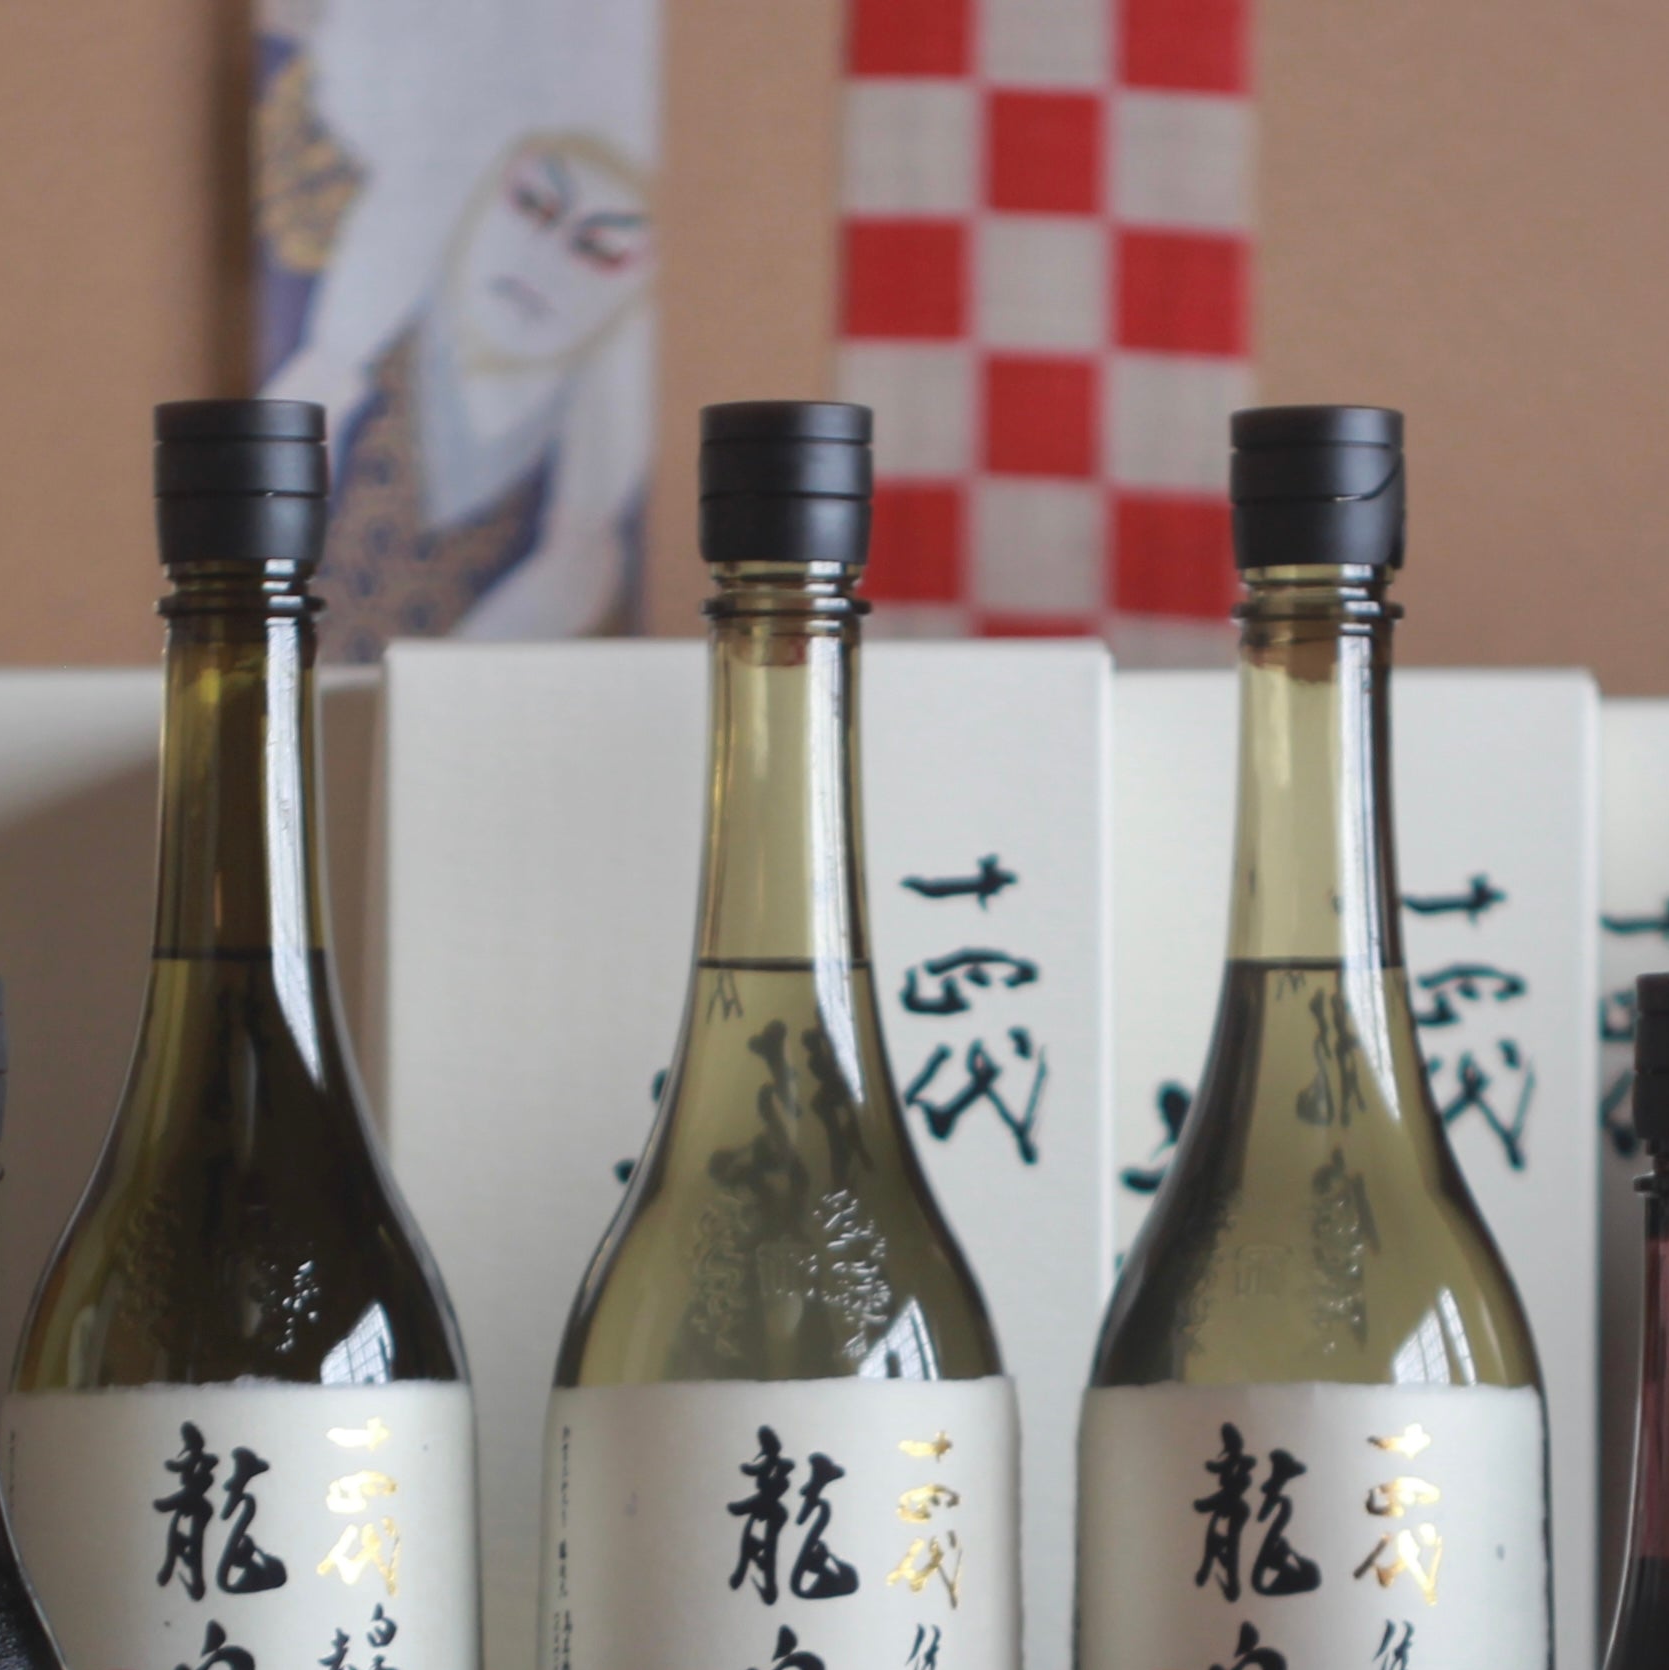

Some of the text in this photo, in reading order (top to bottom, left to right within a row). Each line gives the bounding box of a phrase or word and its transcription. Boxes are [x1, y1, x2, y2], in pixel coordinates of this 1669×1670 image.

[901, 853, 1047, 1165] 十四代
[317, 1416, 401, 1597] 十四代
[887, 1431, 963, 1610] 十四代
[1354, 1423, 1442, 1607] 十四代
